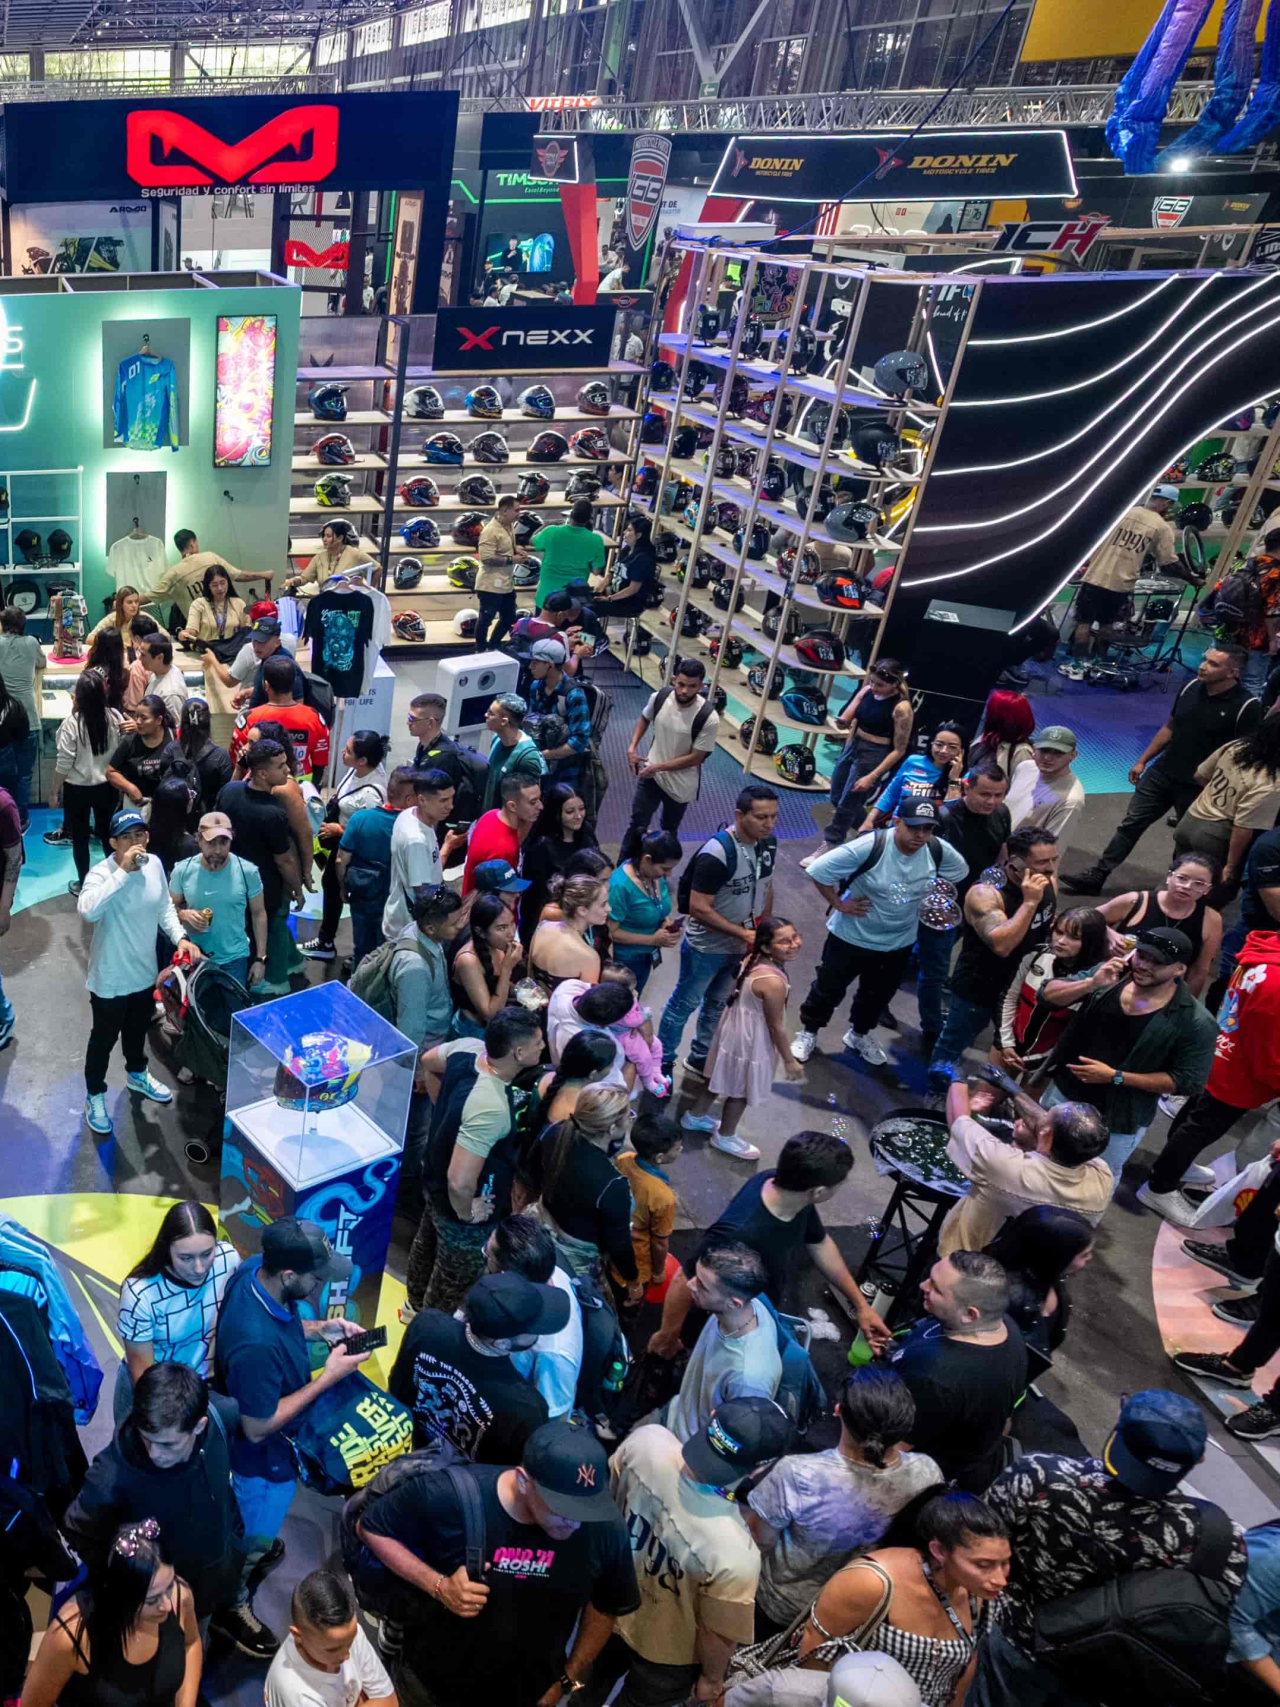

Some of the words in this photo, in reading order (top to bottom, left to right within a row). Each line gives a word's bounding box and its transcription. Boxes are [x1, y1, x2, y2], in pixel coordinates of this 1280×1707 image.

[748, 157, 804, 170] DONIN
[907, 153, 1018, 169] DONIN
[141, 186, 199, 199] Seguridad
[214, 185, 256, 196] confort
[260, 185, 276, 194] sin
[279, 183, 315, 194] límites
[991, 221, 1113, 262] ICH
[1112, 528, 1152, 554] 1998
[359, 698, 374, 706] LIFE
[439, 1360, 453, 1372] THE
[453, 1368, 477, 1395] DRAGON
[498, 1556, 549, 1574] ROSHI
